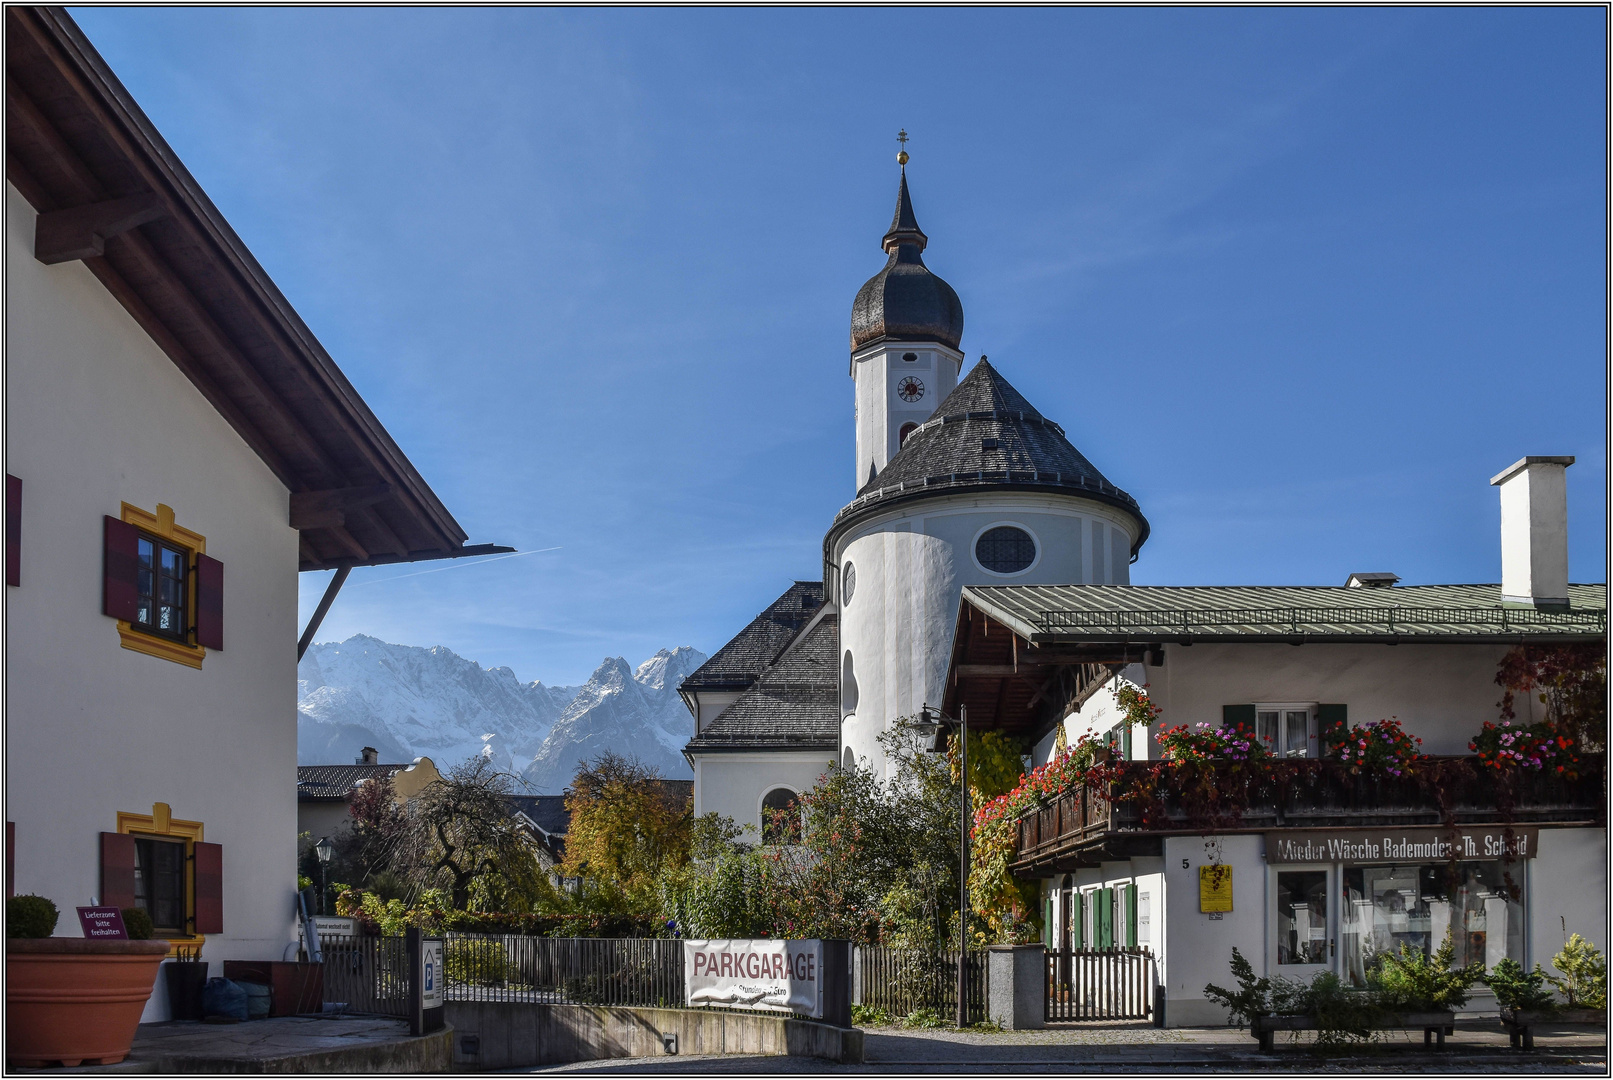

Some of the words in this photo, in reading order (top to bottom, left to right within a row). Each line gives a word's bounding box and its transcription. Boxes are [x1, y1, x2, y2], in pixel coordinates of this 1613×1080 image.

[1277, 839, 1326, 860] Mieder
[1327, 838, 1379, 860] Wäsche
[1462, 835, 1479, 857] Th.
[1182, 858, 1190, 870] 5
[427, 967, 431, 987] P
[693, 952, 815, 982] PARKGARAGE
